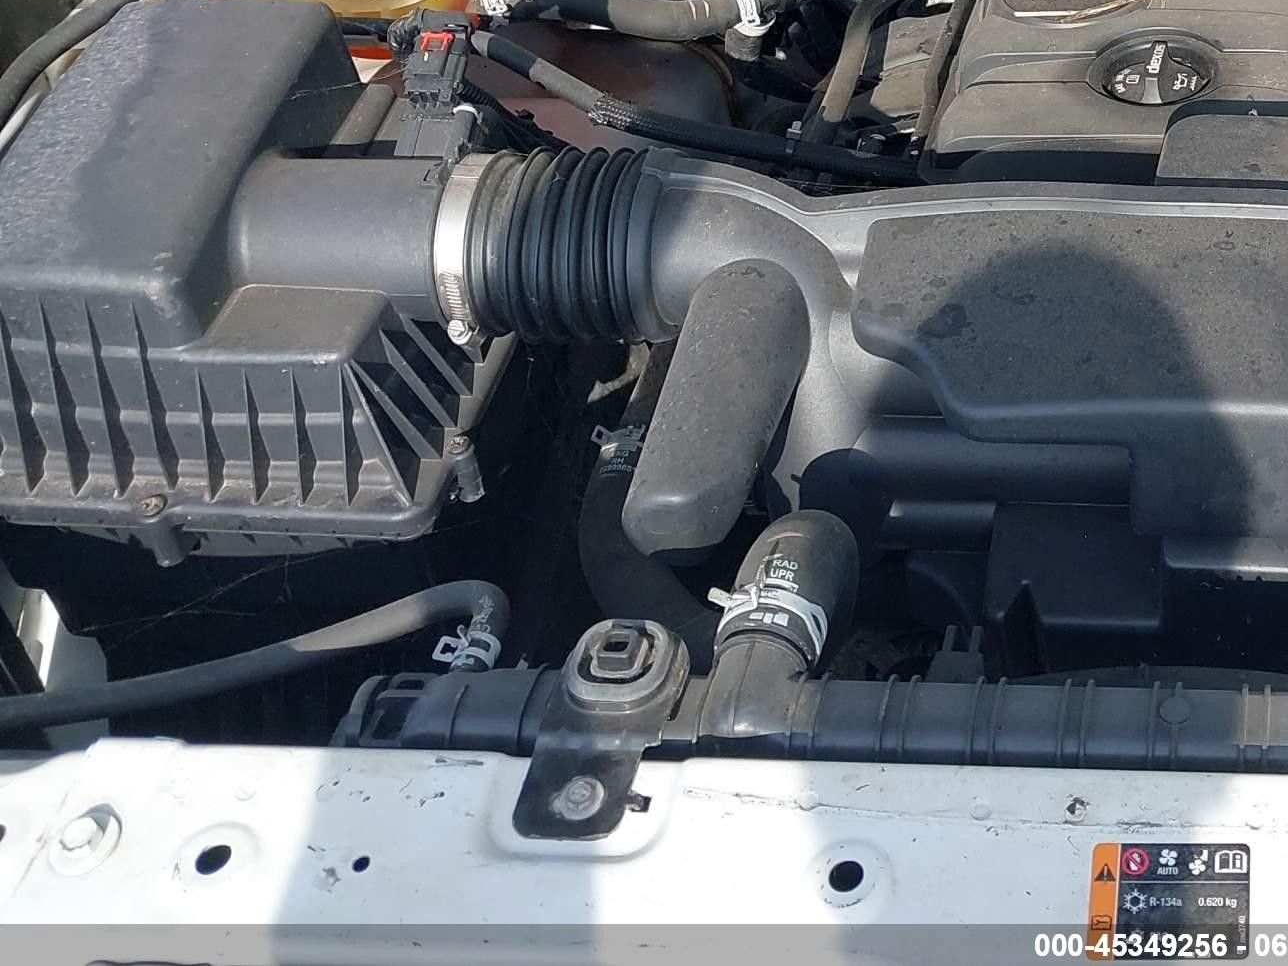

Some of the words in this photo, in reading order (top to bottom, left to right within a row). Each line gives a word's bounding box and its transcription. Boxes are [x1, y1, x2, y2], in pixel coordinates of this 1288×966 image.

[1145, 43, 1166, 74] dexos
[772, 559, 798, 571] RAD
[770, 567, 794, 582] UPR
[1157, 866, 1179, 875] AUTO
[1149, 897, 1183, 907] R-134a
[1198, 897, 1223, 907] 0.620
[1225, 897, 1238, 909] kg
